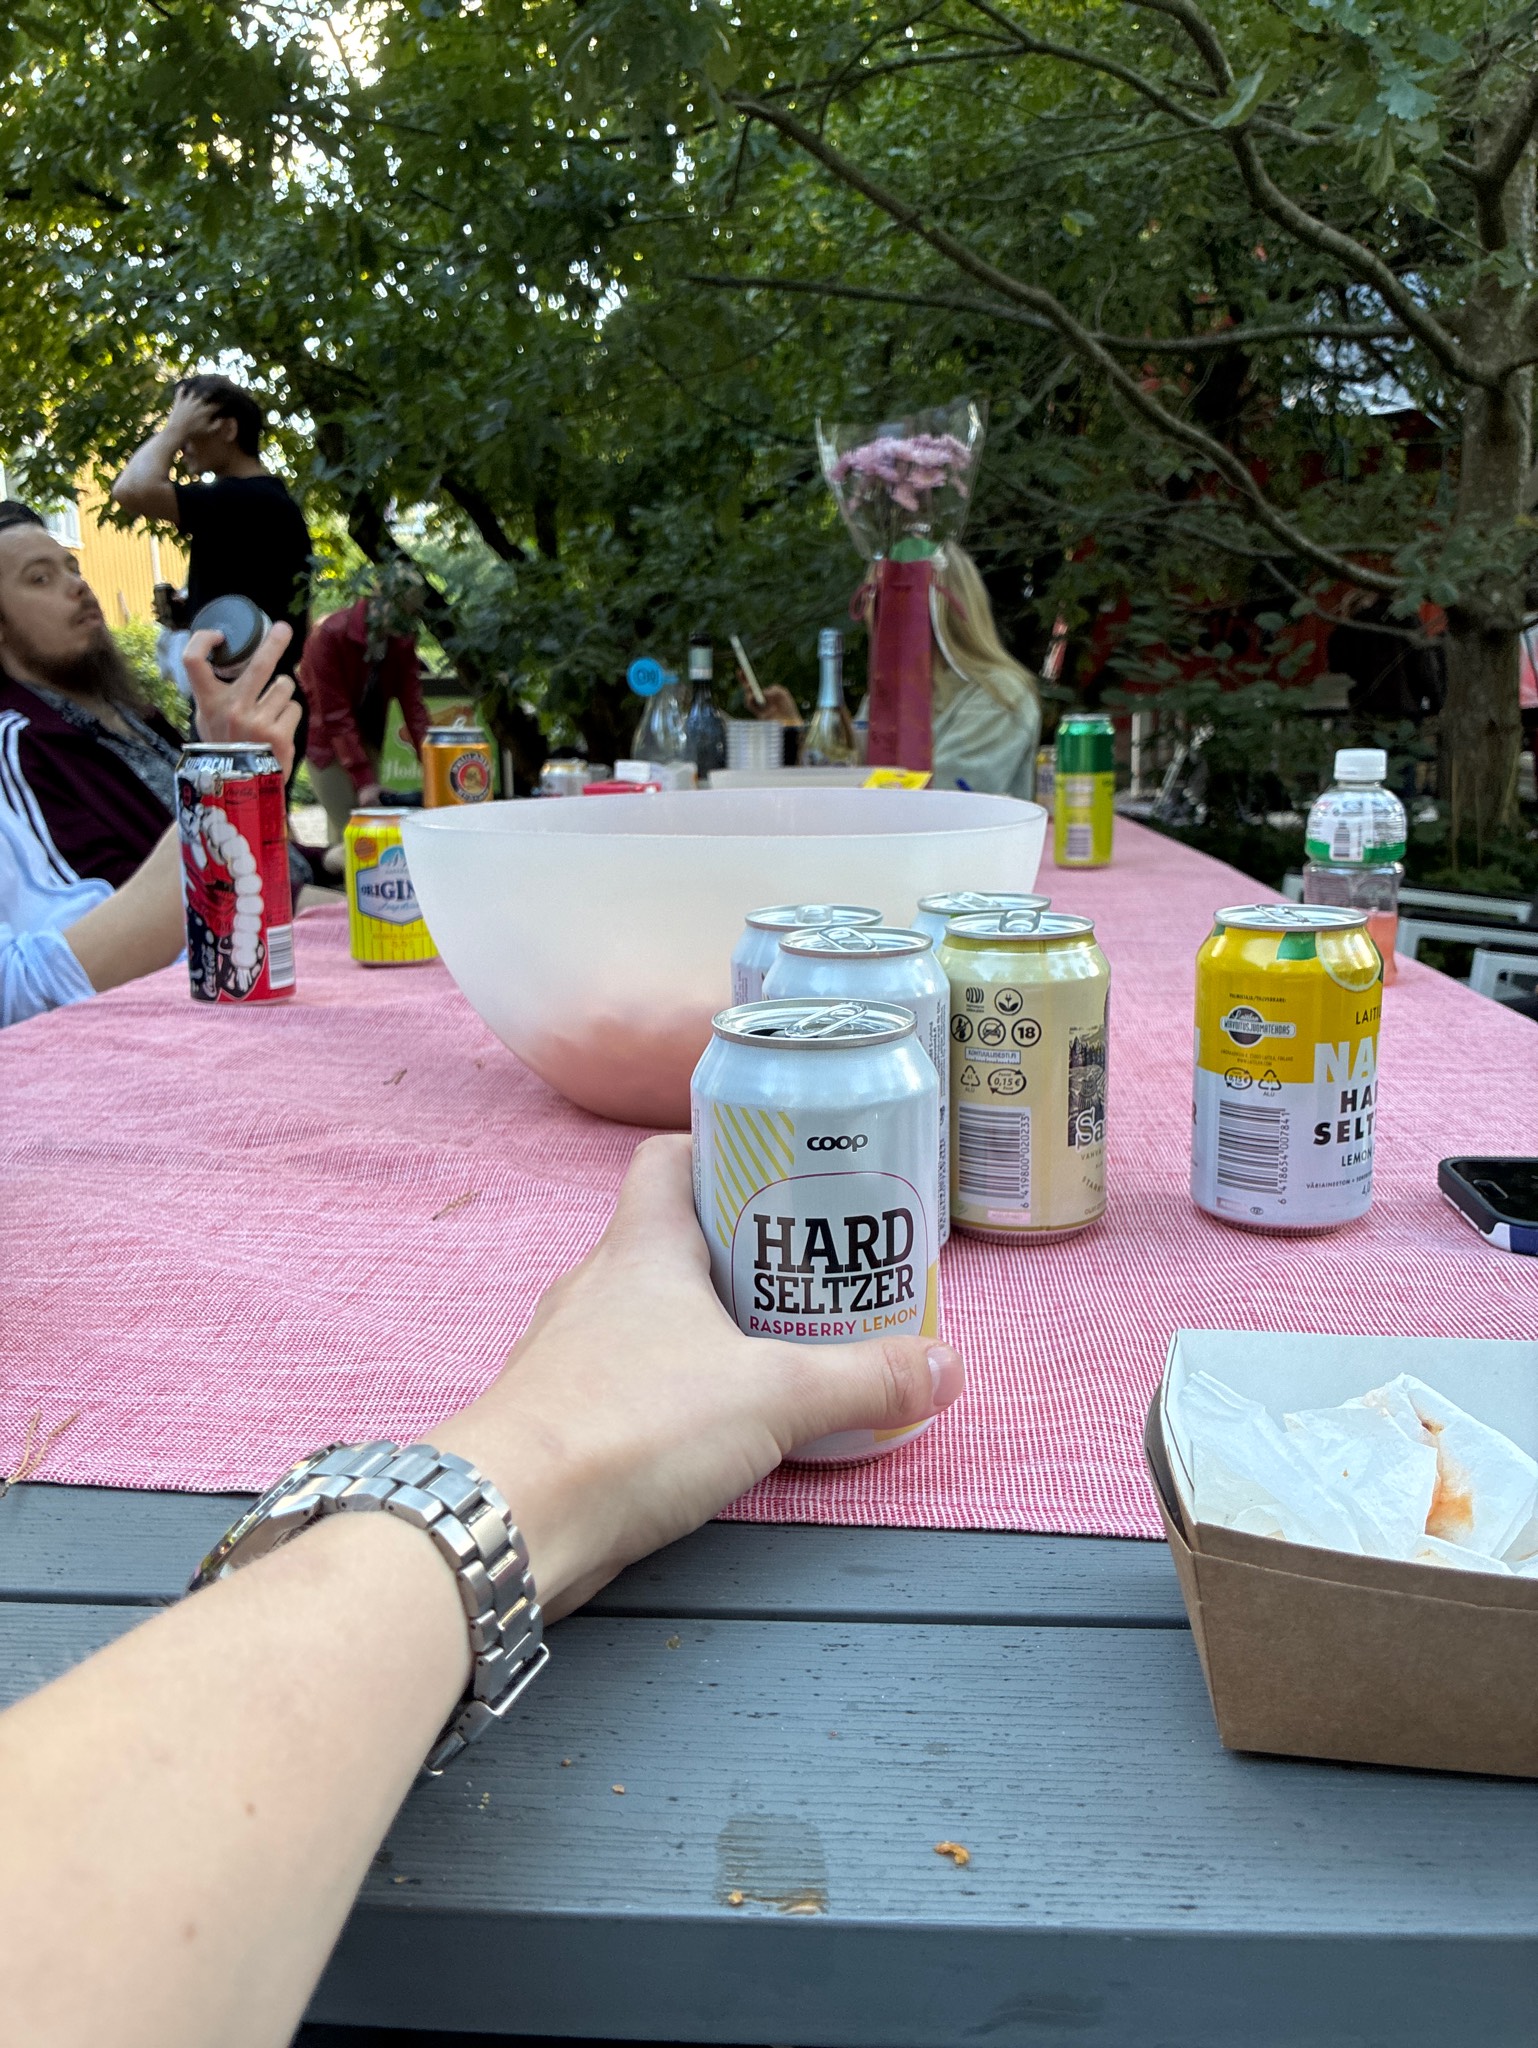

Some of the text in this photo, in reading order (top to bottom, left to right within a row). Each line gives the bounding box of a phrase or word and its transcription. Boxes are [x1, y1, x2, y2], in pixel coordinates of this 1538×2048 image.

[1017, 1026, 1036, 1039] 18
[1340, 1080, 1378, 1114] HA
[806, 1134, 869, 1153] coop
[1341, 1146, 1372, 1167] LEMON
[753, 1207, 914, 1275] HARD
[753, 1263, 915, 1315] SELTZER
[750, 1303, 917, 1337] RASPBERRY LEMON
